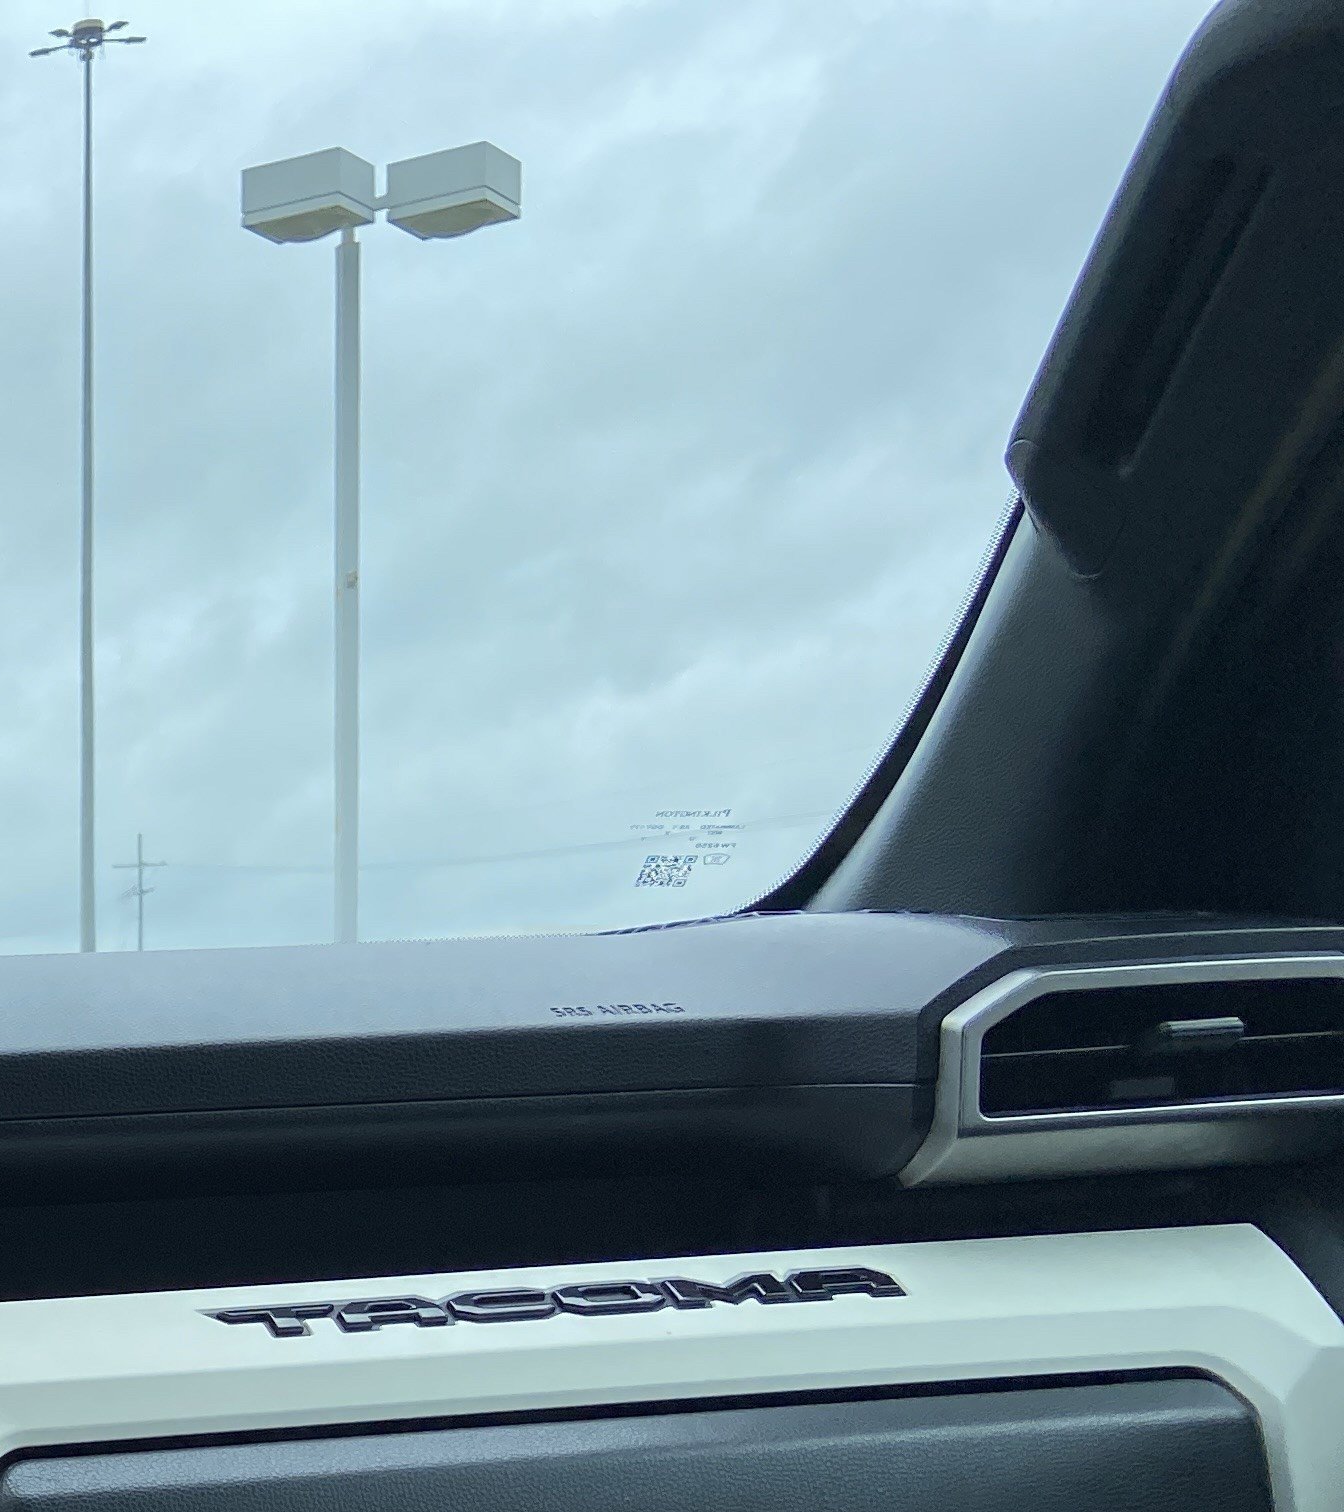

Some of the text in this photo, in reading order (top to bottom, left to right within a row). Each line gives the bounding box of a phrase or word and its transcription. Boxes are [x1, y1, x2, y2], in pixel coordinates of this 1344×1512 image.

[549, 1002, 686, 1018] SRS AIRBAG
[212, 1265, 911, 1338] TACOMA
